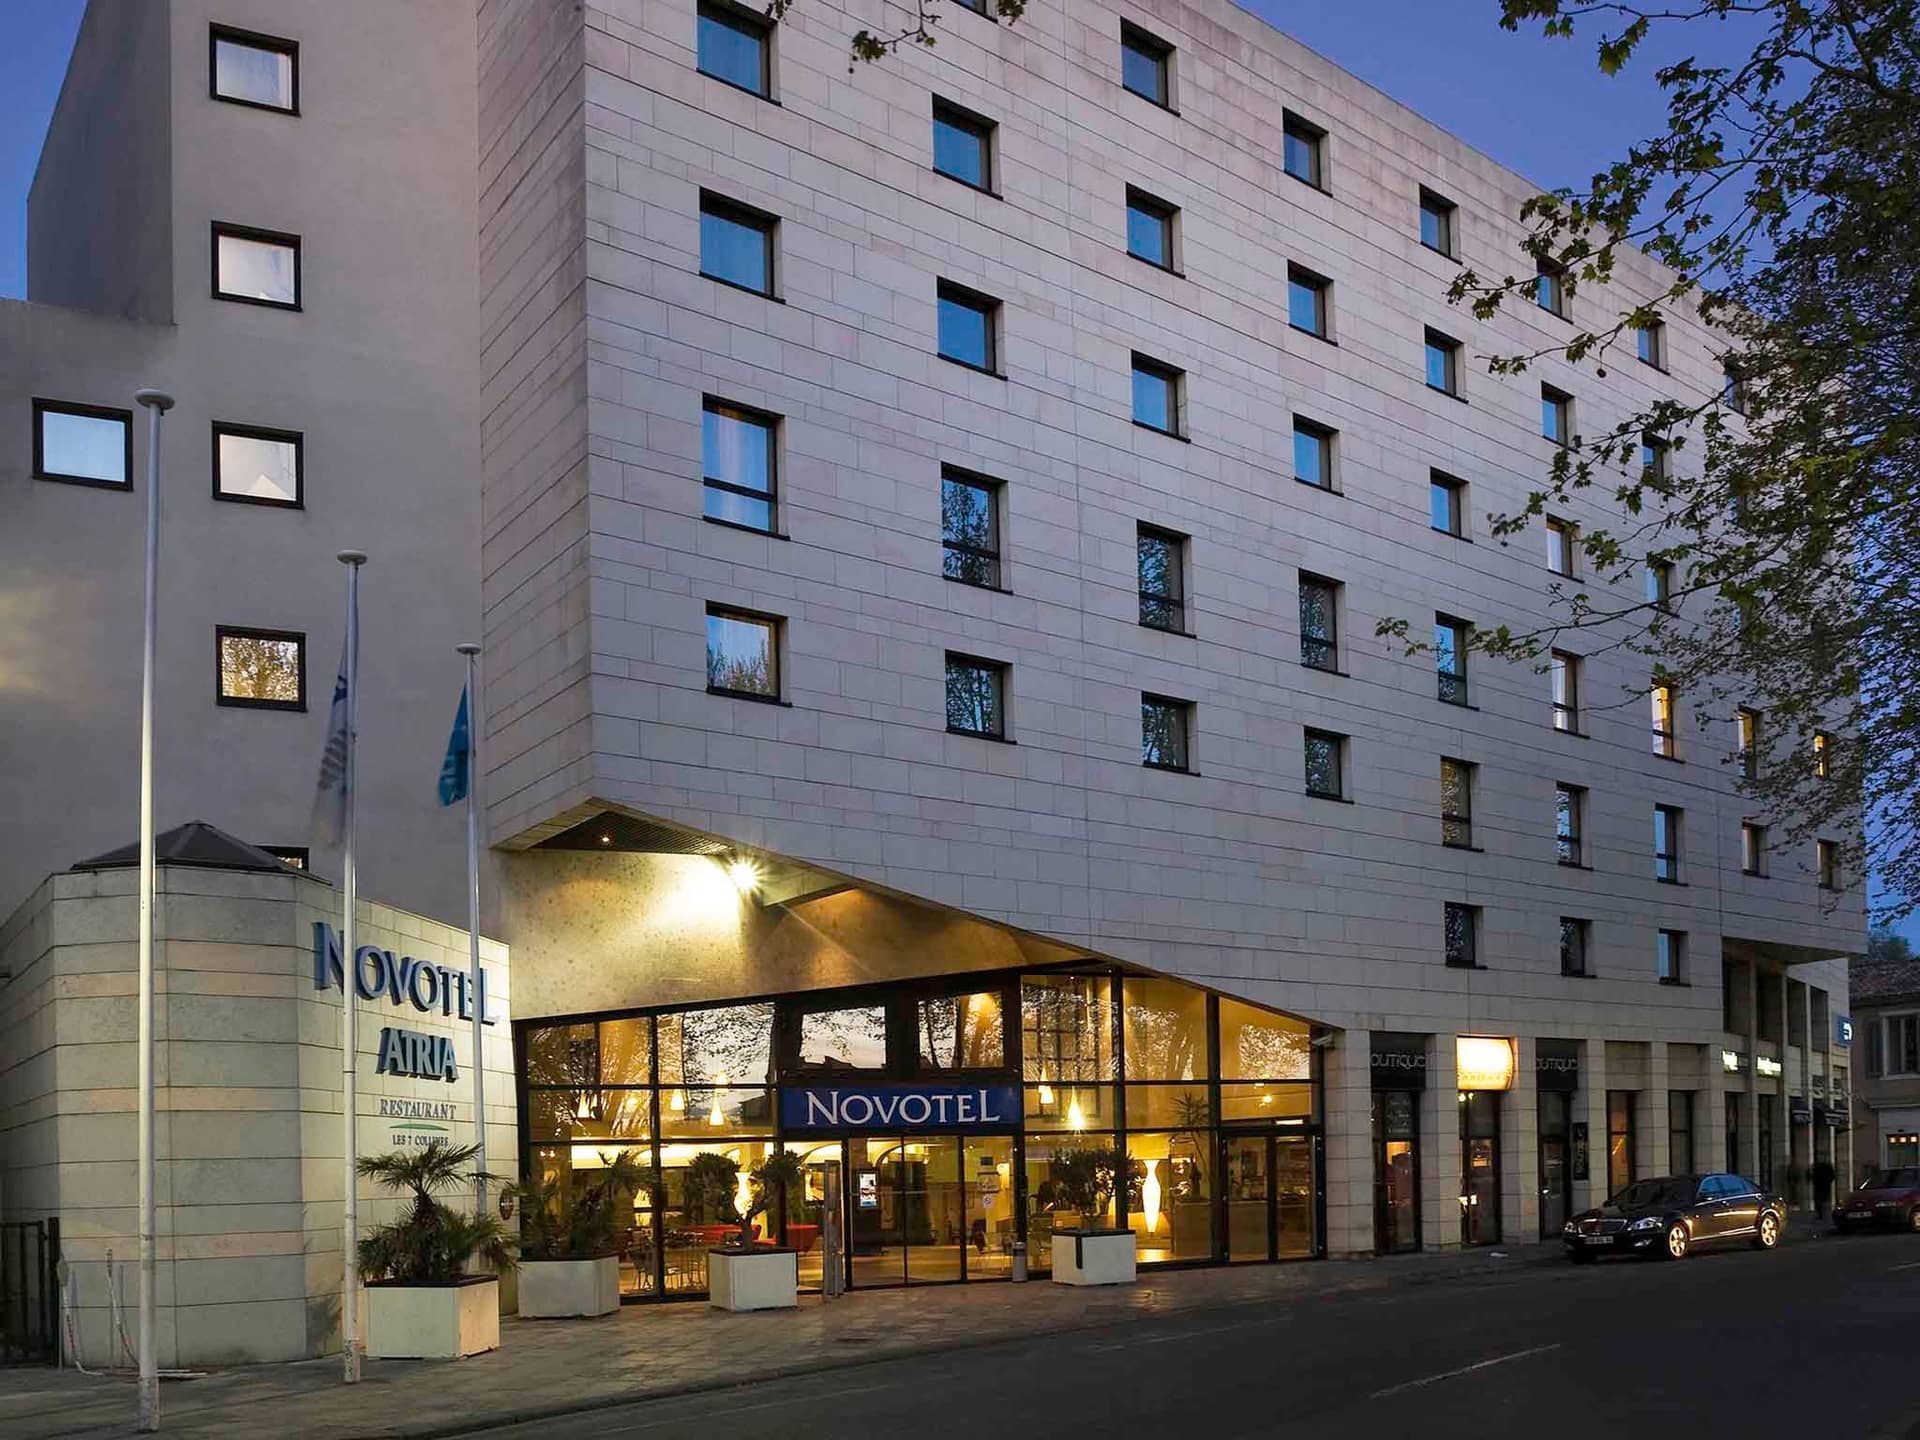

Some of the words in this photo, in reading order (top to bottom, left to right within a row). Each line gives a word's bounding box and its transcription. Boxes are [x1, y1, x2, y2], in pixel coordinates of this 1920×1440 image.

[313, 921, 498, 1025] NOVOTEL
[376, 1027, 458, 1082] ATRIA
[380, 1099, 456, 1120] RESTAURANT
[806, 1089, 1000, 1125] NOVOTEL
[392, 1134, 406, 1146] LES
